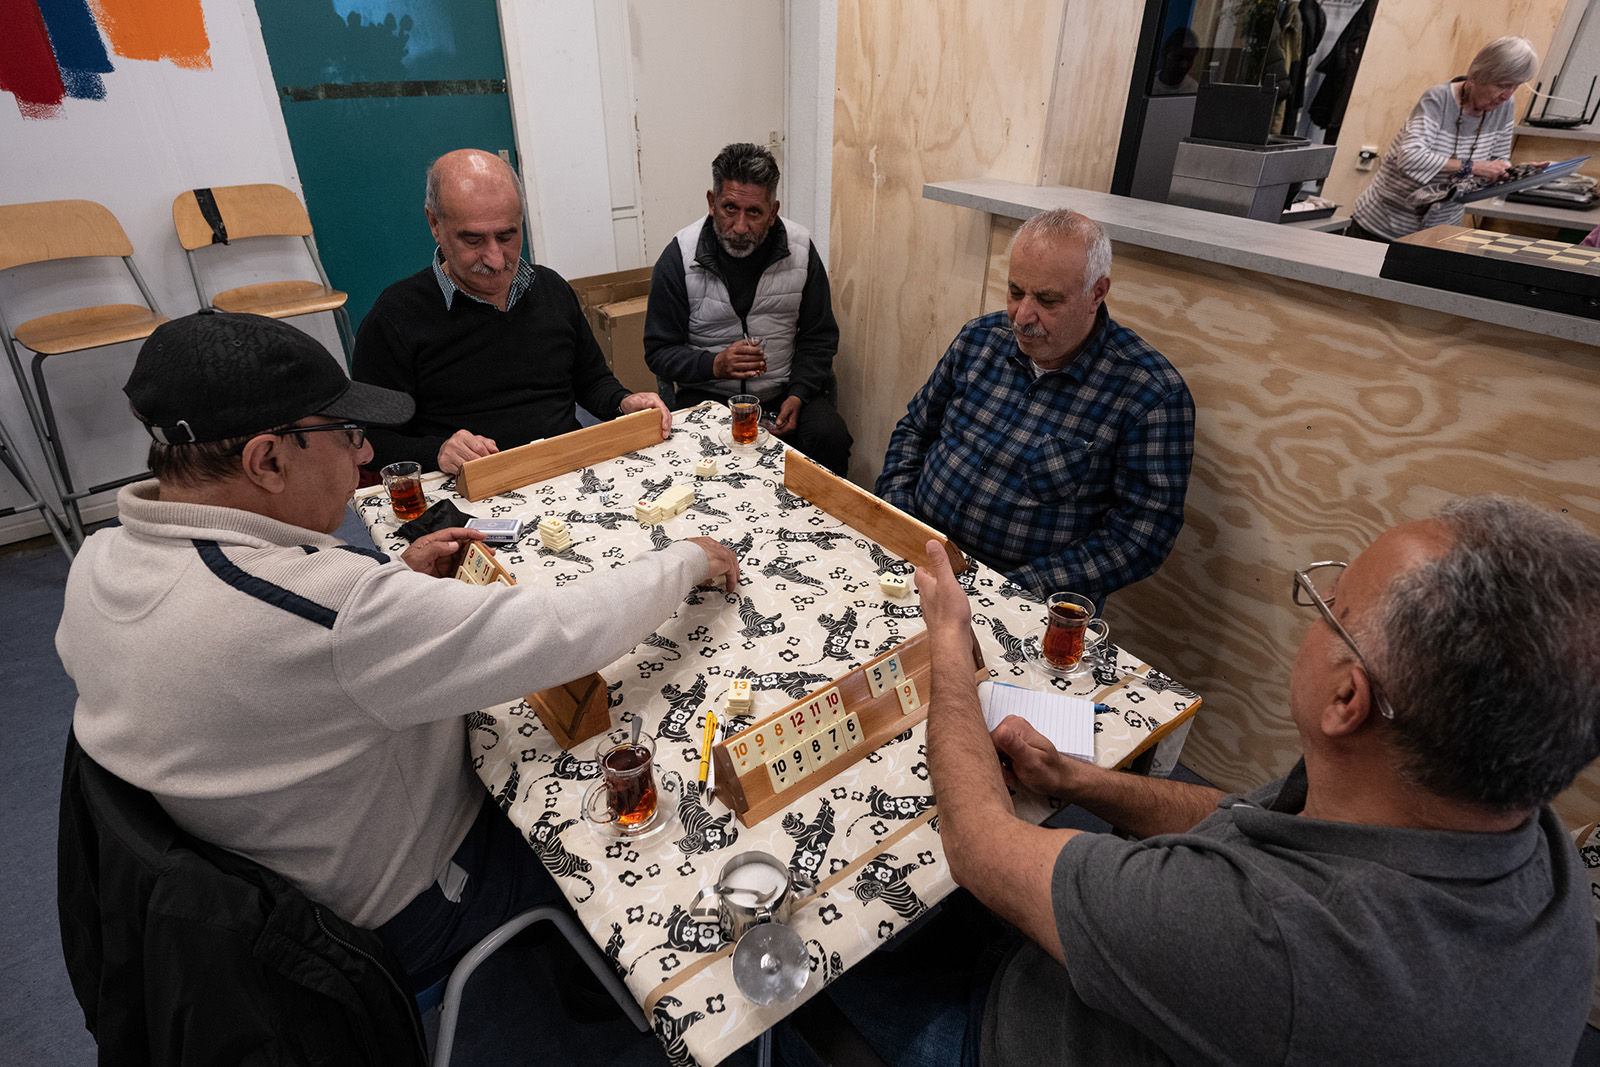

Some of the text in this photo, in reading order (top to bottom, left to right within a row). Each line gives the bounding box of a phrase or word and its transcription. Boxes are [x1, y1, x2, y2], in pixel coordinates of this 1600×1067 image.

[469, 549, 490, 577] 9 11
[873, 659, 897, 681] 5 5
[733, 681, 748, 690] 13
[903, 685, 912, 698] 9
[732, 692, 839, 759] 10 9 8 12 11 10
[772, 719, 855, 776] 10 9 8 7 6
